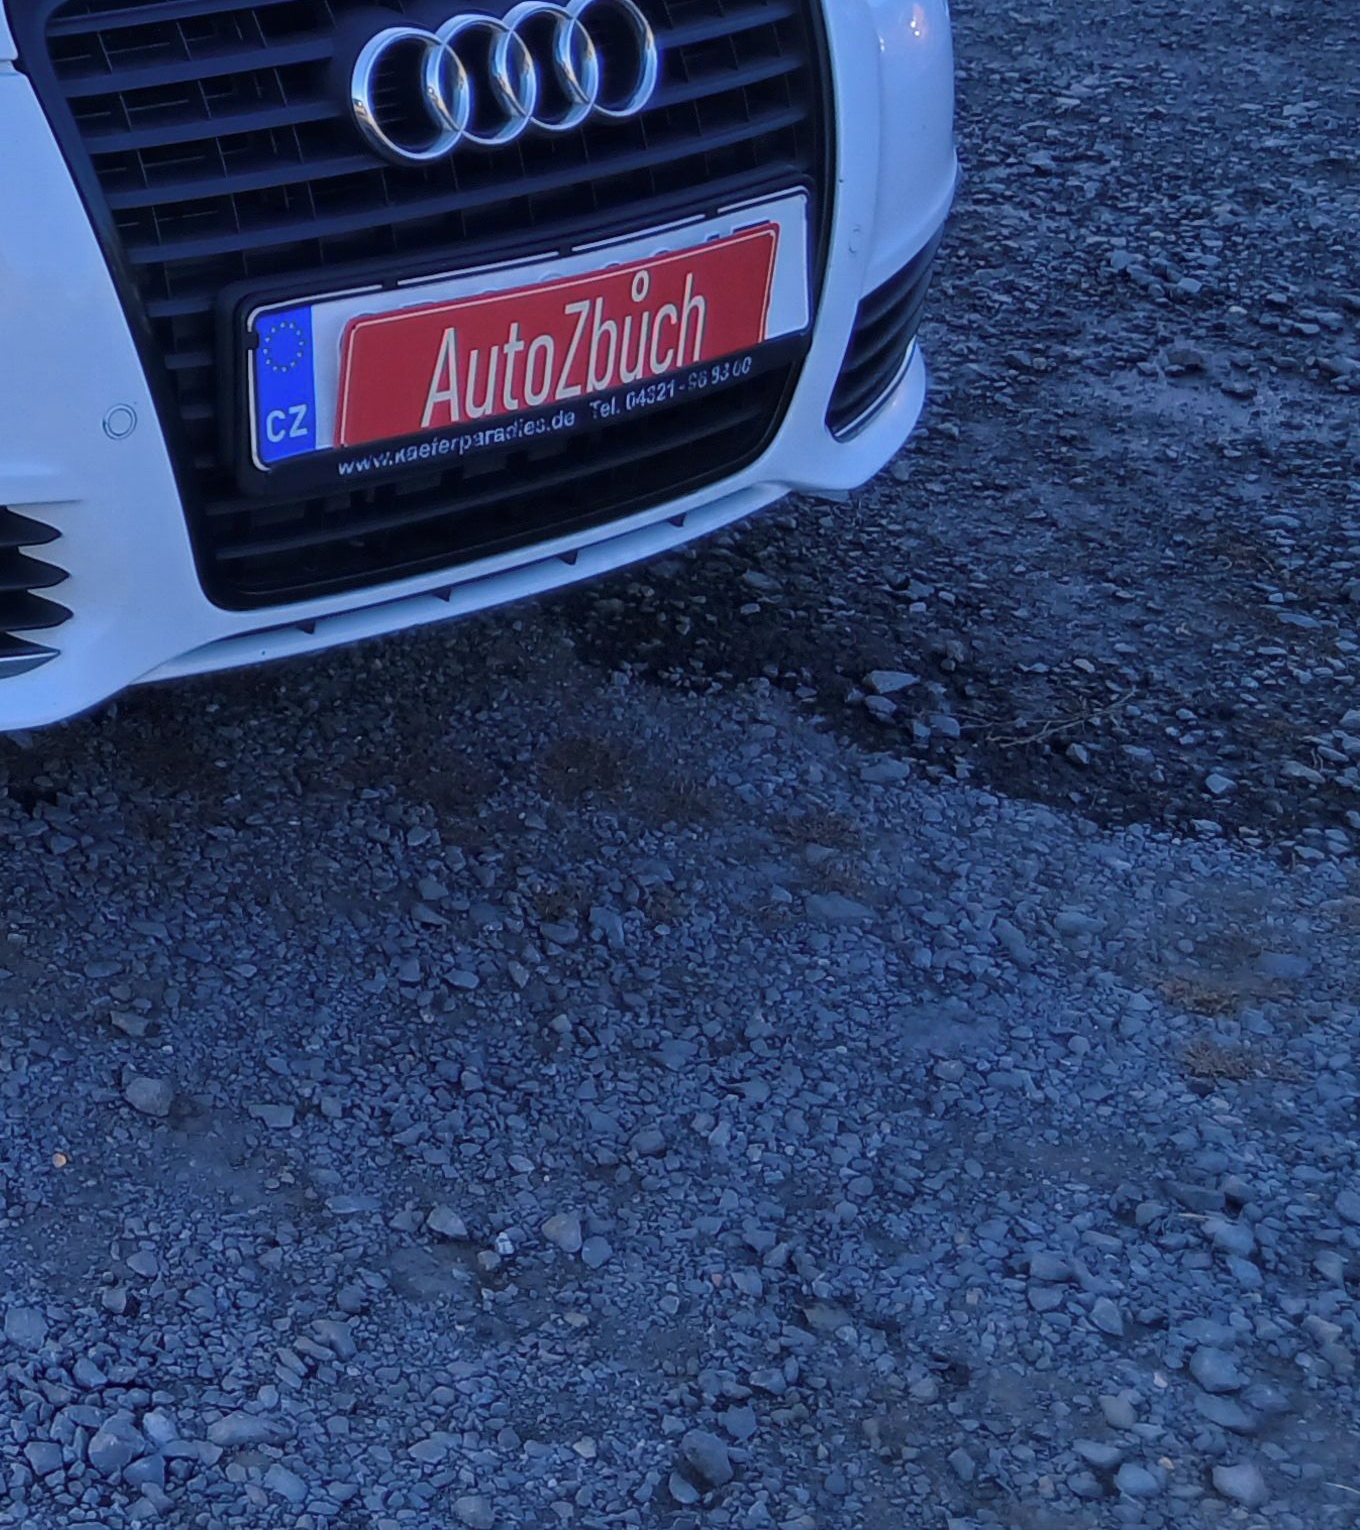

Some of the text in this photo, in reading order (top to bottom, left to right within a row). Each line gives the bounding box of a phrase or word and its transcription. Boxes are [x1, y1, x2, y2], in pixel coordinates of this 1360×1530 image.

[420, 270, 708, 428] AutoZbůch
[265, 403, 310, 443] CZ
[589, 396, 620, 419] Tel.
